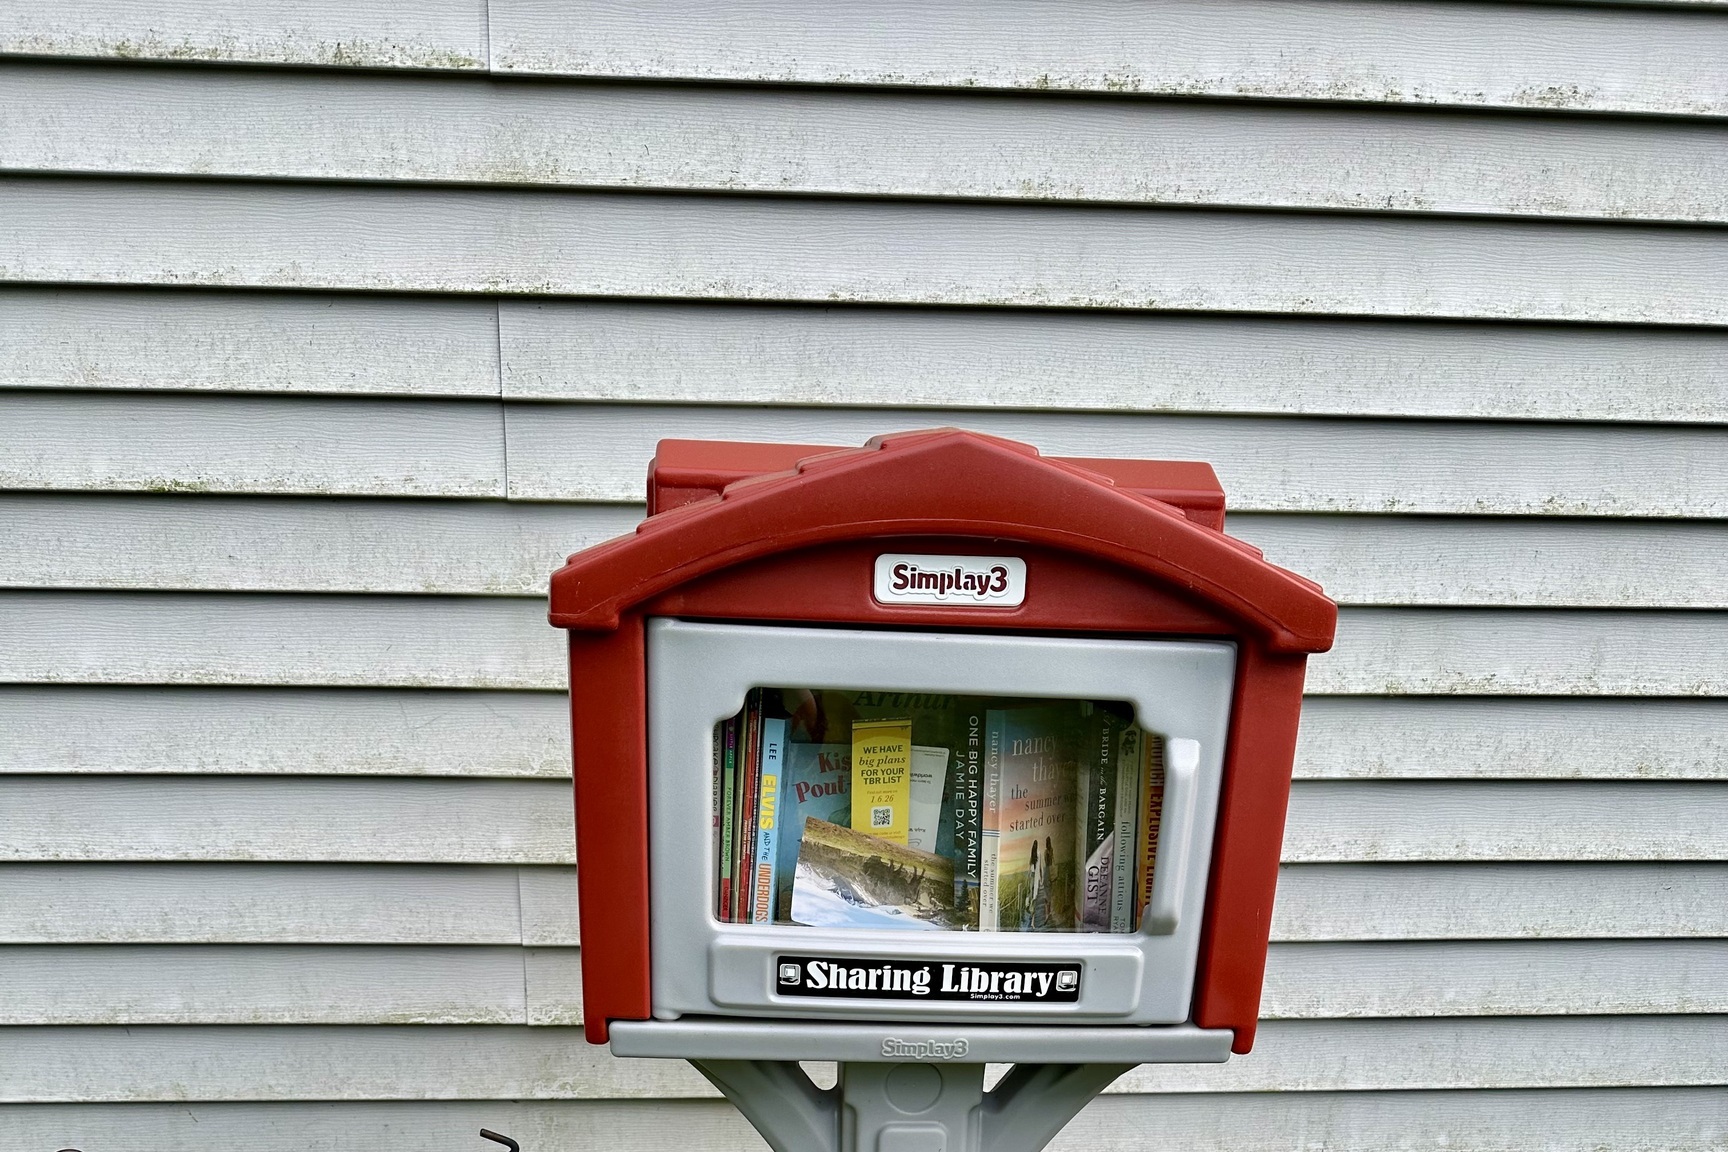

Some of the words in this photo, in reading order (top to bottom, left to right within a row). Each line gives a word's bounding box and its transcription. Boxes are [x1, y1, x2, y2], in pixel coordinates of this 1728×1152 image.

[893, 564, 1008, 595] Simplay3
[968, 715, 979, 747] ONE
[1101, 727, 1110, 765] BRIDE
[768, 743, 777, 761] LEE
[859, 756, 875, 768] big
[876, 755, 906, 768] plans
[863, 746, 878, 754] WE
[879, 745, 904, 753] HAVE
[987, 731, 999, 769] nancy
[1012, 734, 1057, 759] nancy
[817, 751, 851, 773] Kis
[861, 769, 878, 777] FOR
[880, 767, 905, 776] YOUR
[968, 752, 979, 775] BIG
[1032, 757, 1076, 787] thayer
[863, 777, 881, 785] TBR
[882, 776, 902, 784] LIST
[955, 752, 965, 803] JAMIE
[1011, 784, 1029, 799] the
[759, 774, 778, 831] ELVIS
[967, 779, 978, 826] HAPPY
[988, 773, 998, 814] thayer
[1024, 793, 1062, 811] summer
[955, 811, 965, 841] DAY
[1009, 812, 1044, 832] started
[1046, 811, 1066, 825] over
[1096, 788, 1107, 841] BARGAIN
[723, 838, 731, 862] BROWN
[763, 831, 771, 846] AND
[1114, 821, 1131, 872] following
[966, 829, 978, 879] FAMILY
[755, 863, 772, 922] UNDERDOGS
[1087, 865, 1100, 905] GIST
[1098, 856, 1110, 915] DEEANNE
[1116, 876, 1127, 911] atticus
[806, 961, 931, 995] Sharing
[940, 964, 1054, 997] Library
[881, 1037, 969, 1058] Simplay3
